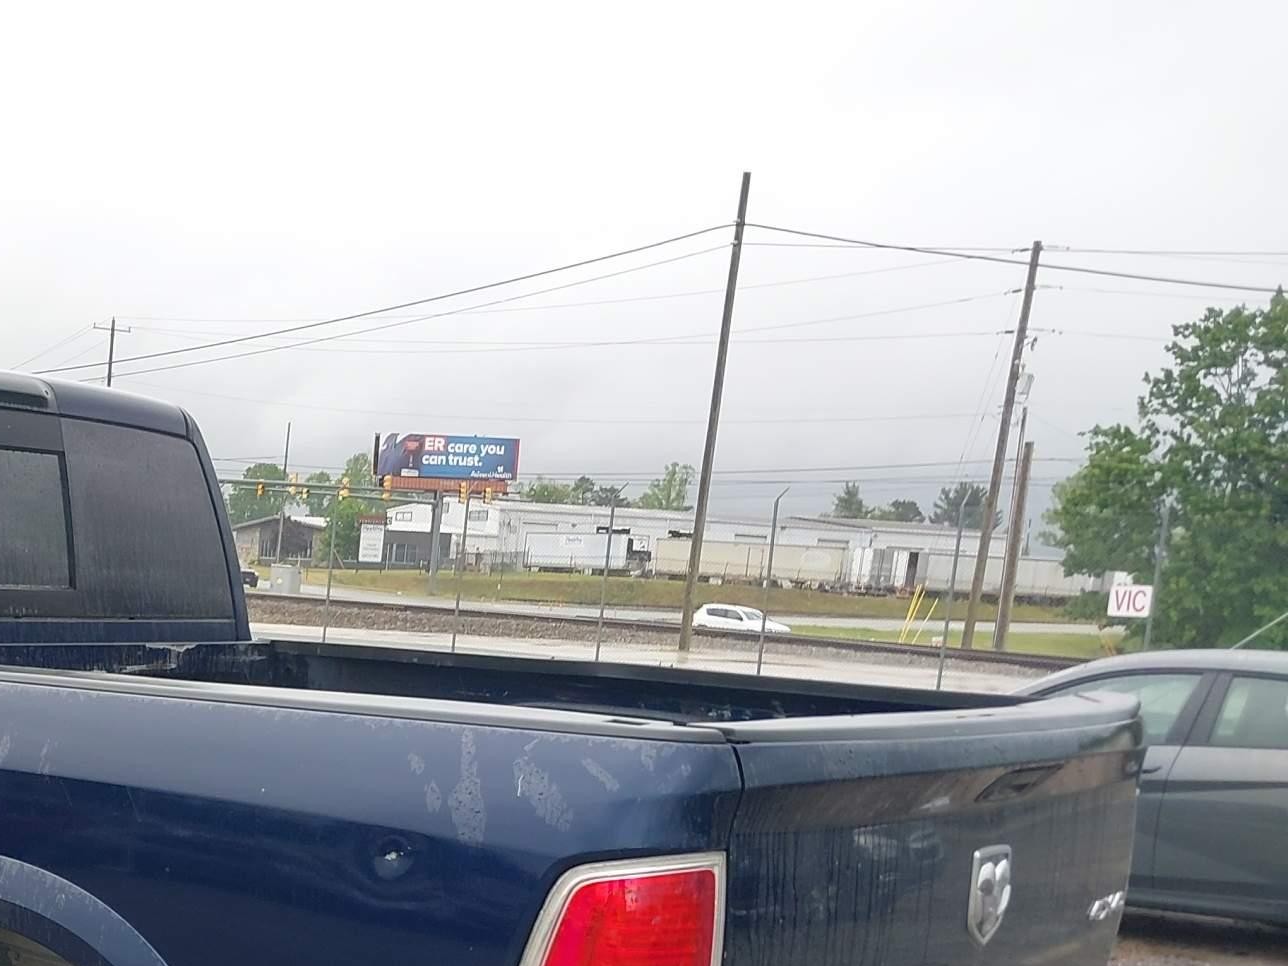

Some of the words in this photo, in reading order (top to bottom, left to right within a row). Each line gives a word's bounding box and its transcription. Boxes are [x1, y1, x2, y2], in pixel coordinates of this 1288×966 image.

[424, 437, 446, 451] ER
[447, 443, 478, 454] care
[480, 443, 505, 456] you
[421, 454, 447, 465] can
[448, 454, 483, 467] trust.
[1115, 590, 1146, 612] VIC
